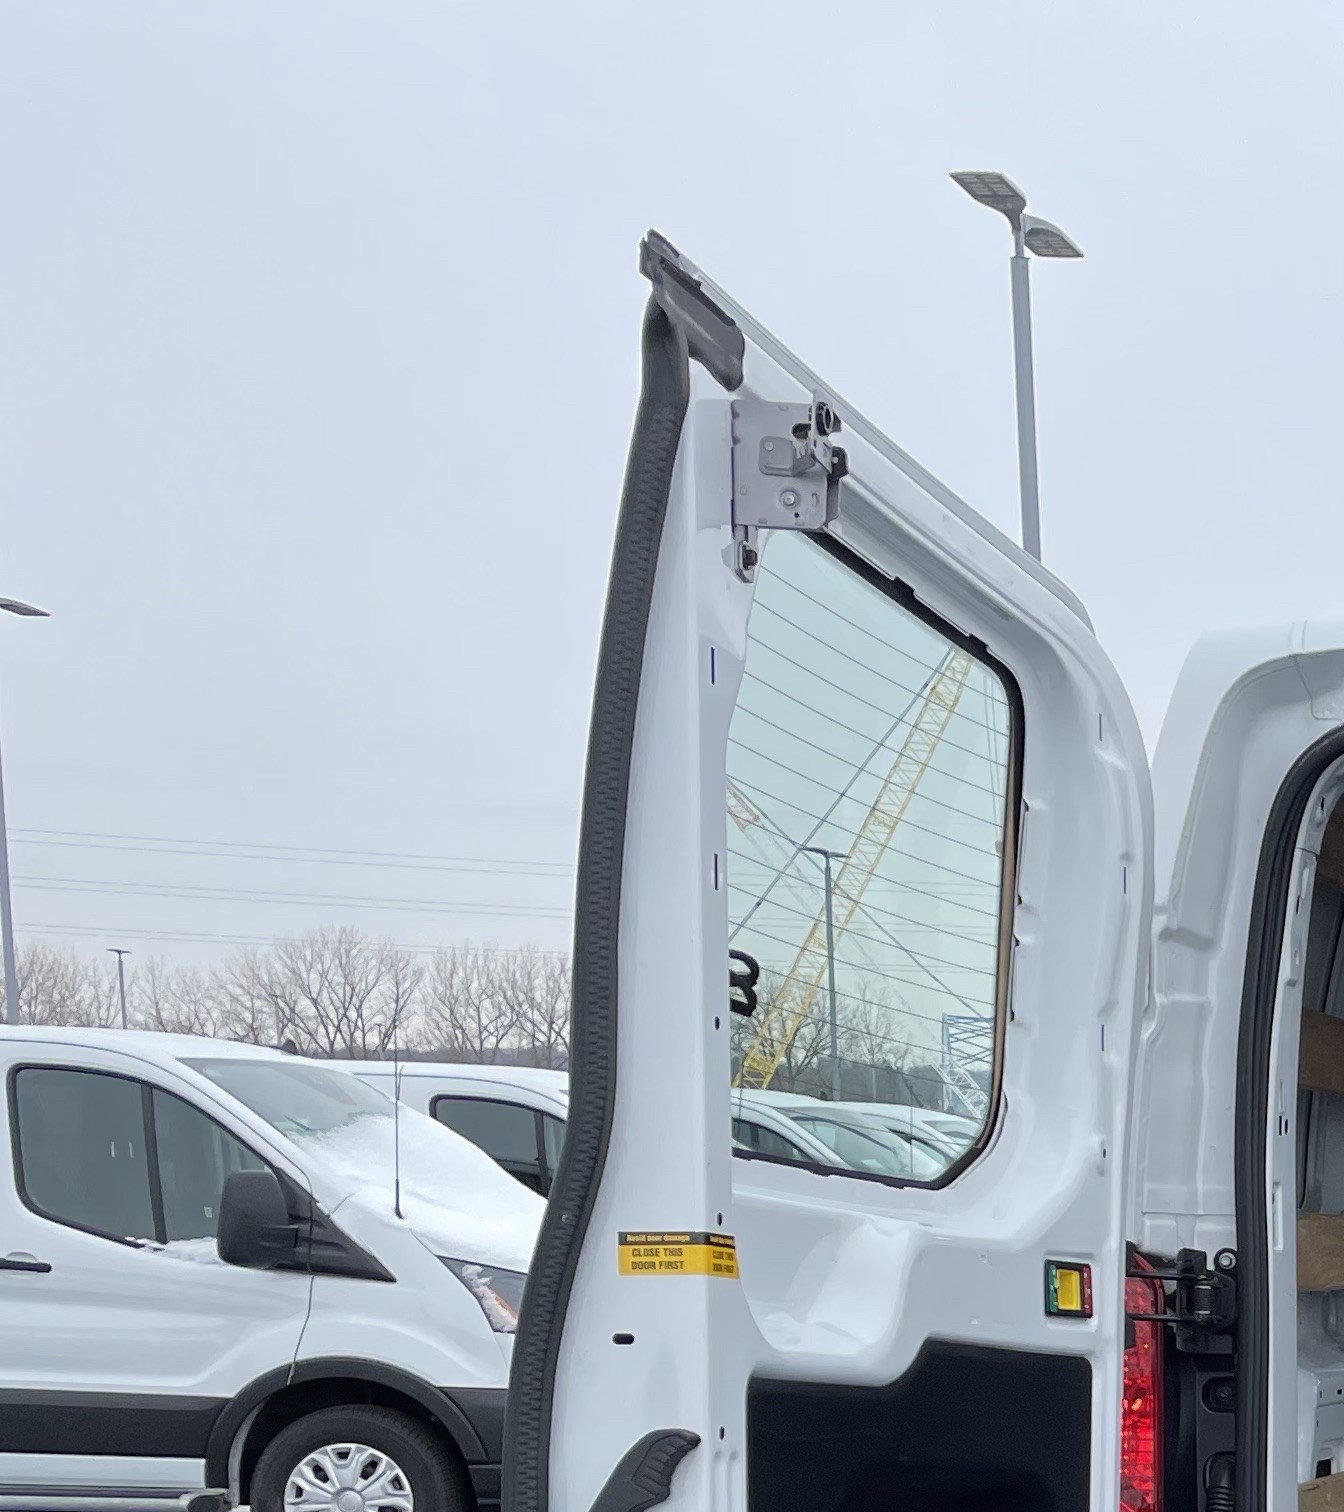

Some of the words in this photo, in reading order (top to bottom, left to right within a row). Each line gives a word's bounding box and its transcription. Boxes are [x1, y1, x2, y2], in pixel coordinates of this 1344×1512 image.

[632, 1247, 660, 1258] CLOSE
[663, 1247, 684, 1257] THIS
[631, 1260, 656, 1270] DOOR
[659, 1260, 685, 1270] FIRST
